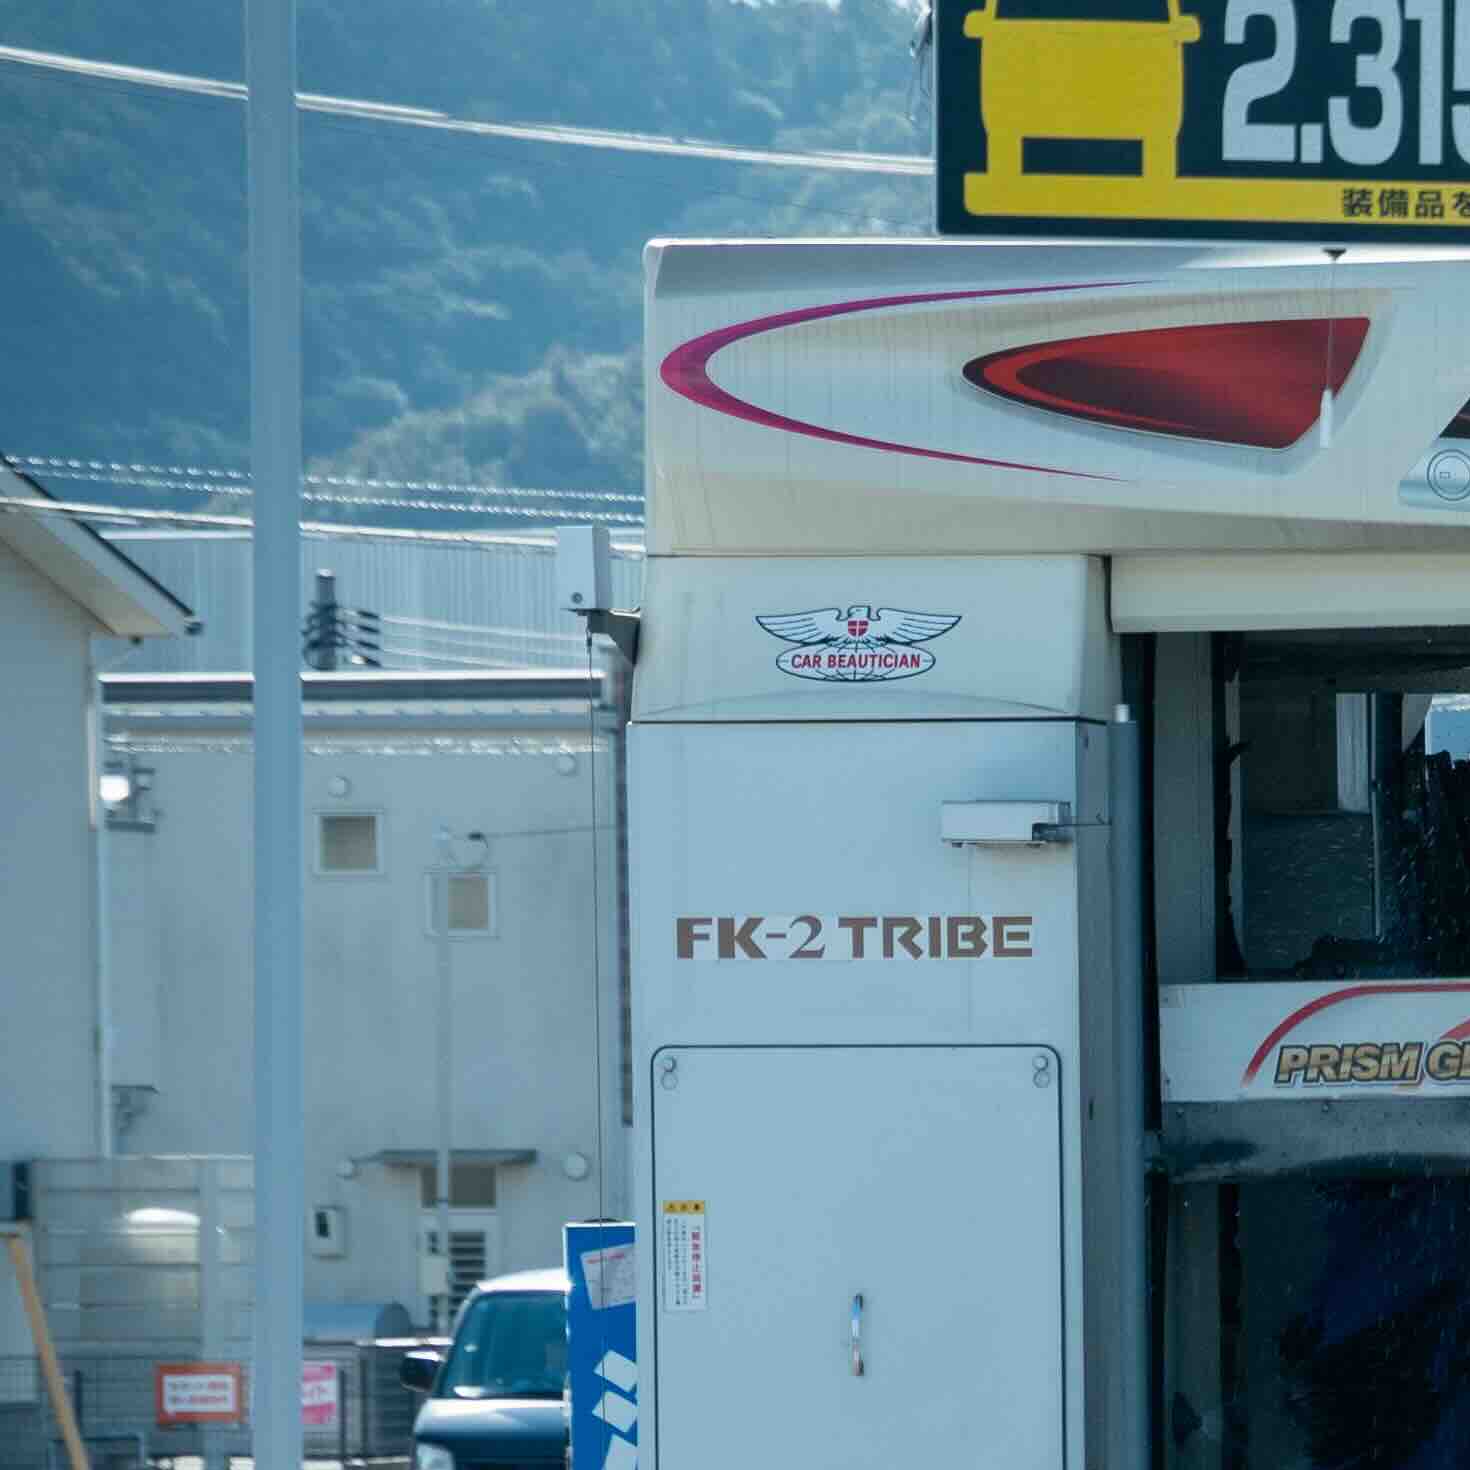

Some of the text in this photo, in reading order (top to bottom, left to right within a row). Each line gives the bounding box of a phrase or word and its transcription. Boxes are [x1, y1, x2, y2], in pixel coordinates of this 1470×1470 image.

[790, 653, 921, 669] CAR BEAUTICIAN
[675, 915, 1033, 960] FK-2 TRIBE
[1274, 1042, 1424, 1084] PRISM
